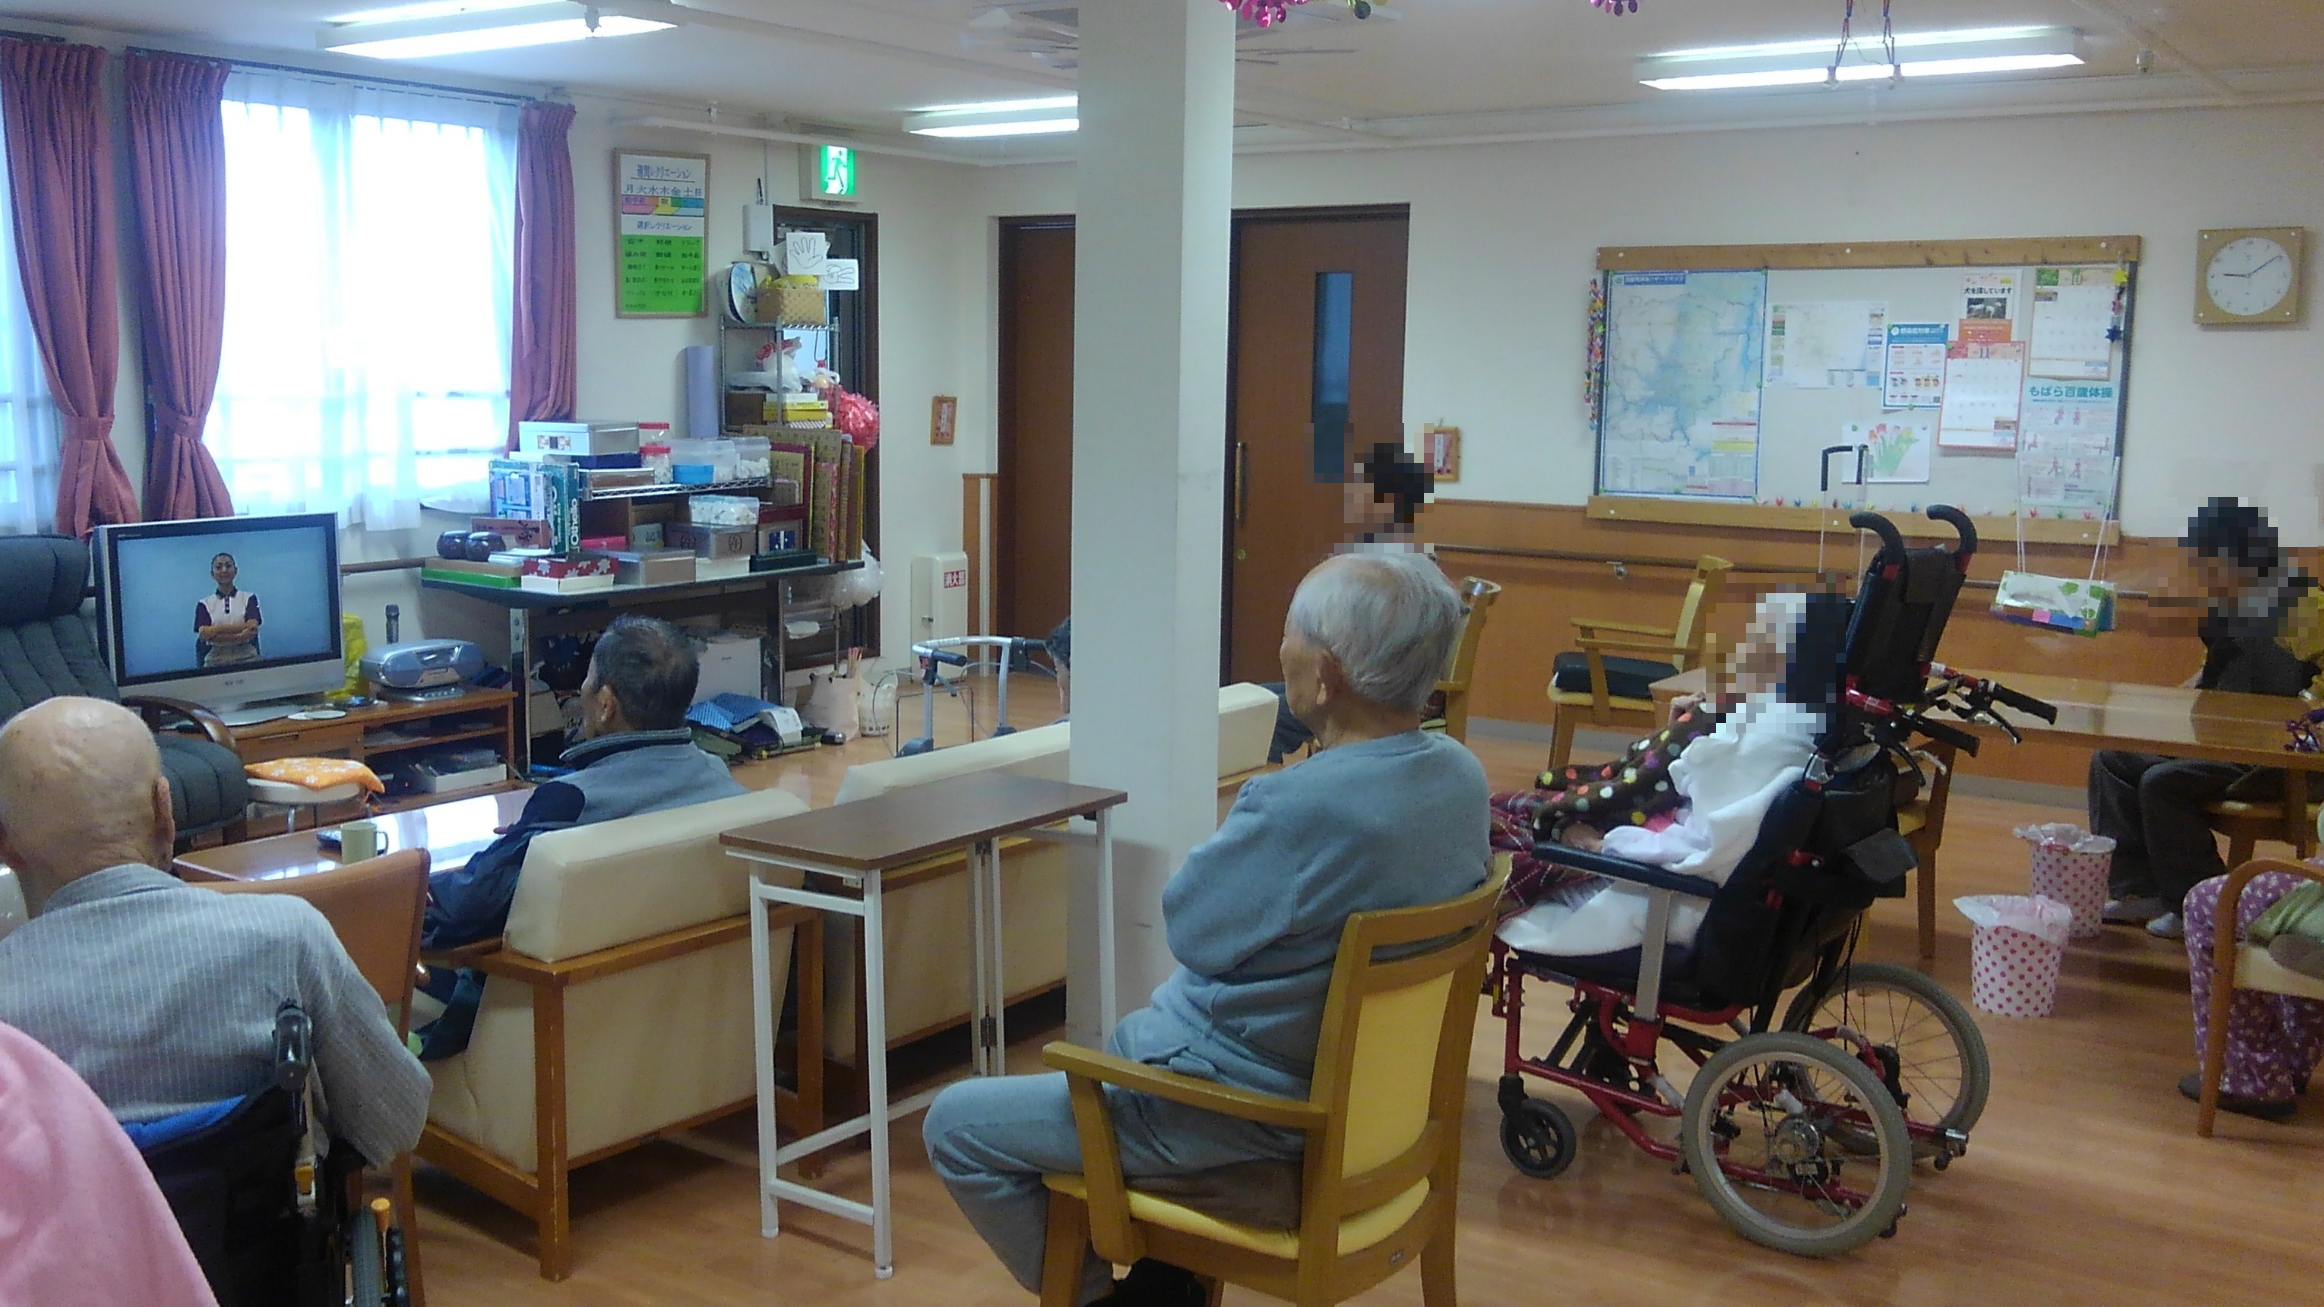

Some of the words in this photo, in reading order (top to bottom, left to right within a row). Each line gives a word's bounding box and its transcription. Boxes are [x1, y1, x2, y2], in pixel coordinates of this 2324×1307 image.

[1963, 286, 2013, 295] 犬を探しています
[2029, 385, 2114, 399] もばら百歳体操
[570, 498, 579, 546] Othello
